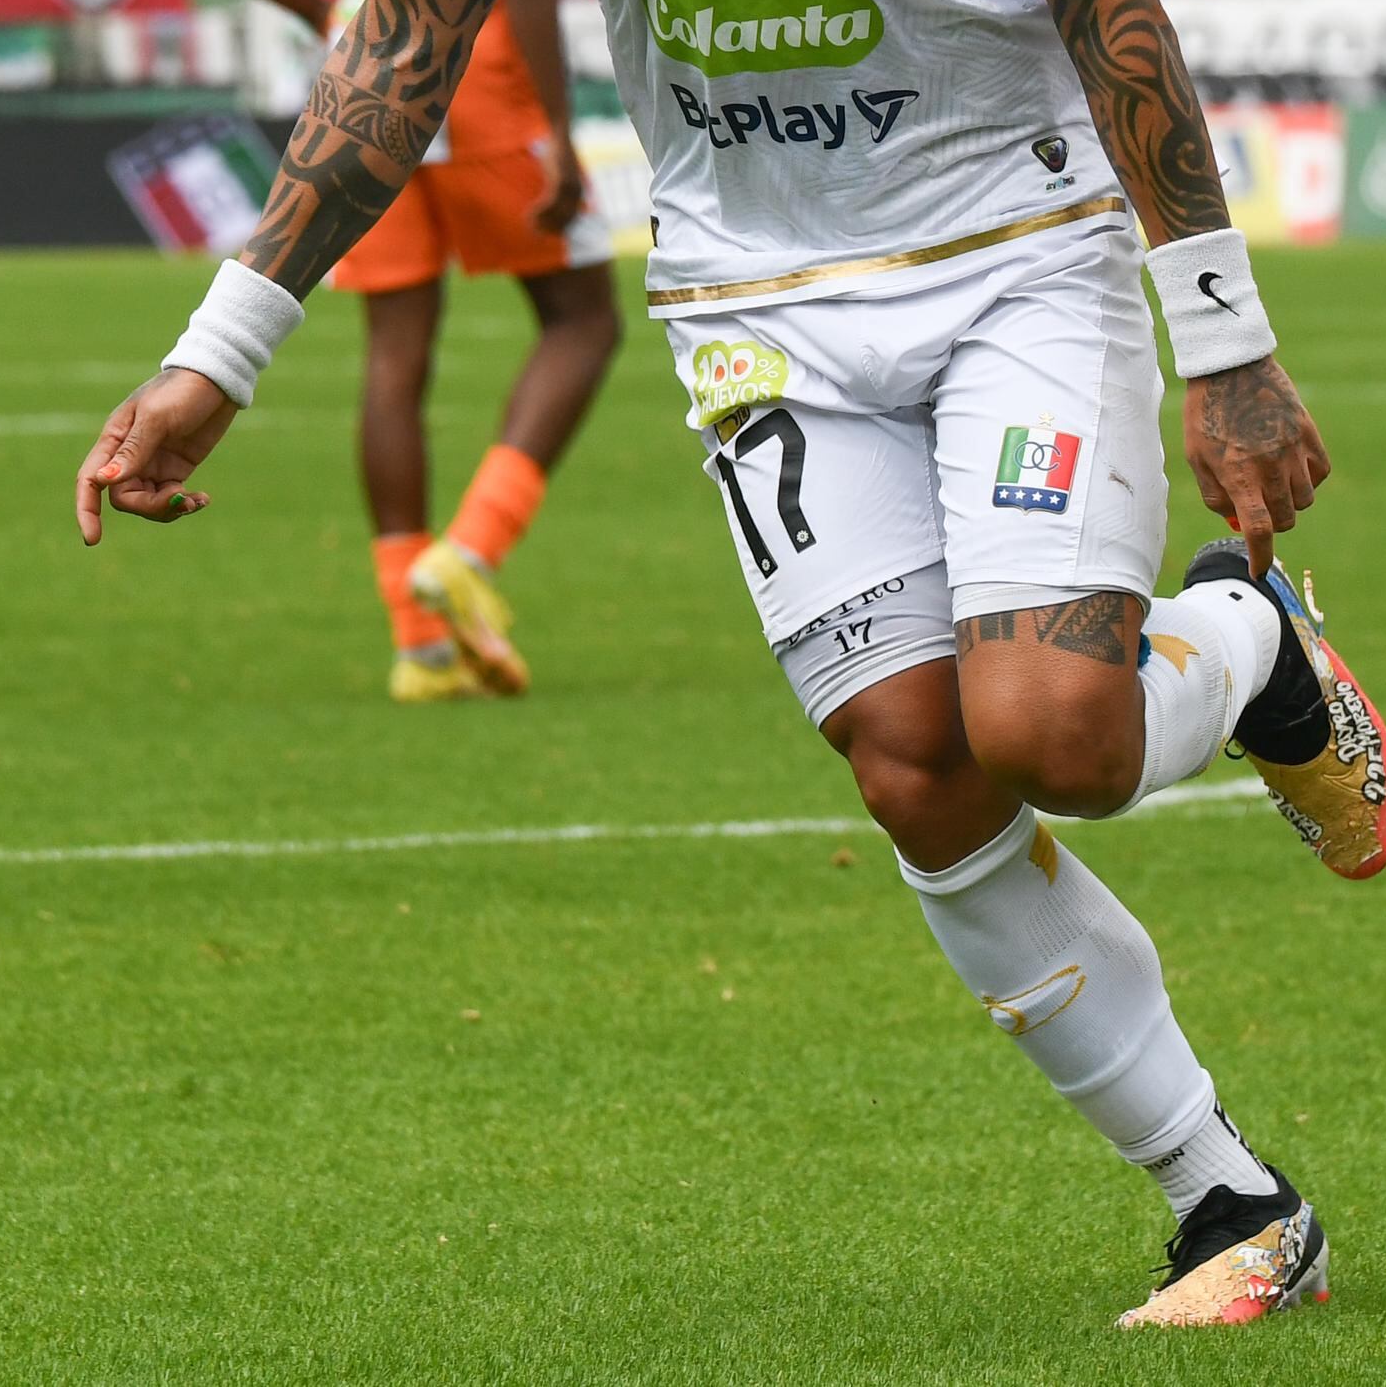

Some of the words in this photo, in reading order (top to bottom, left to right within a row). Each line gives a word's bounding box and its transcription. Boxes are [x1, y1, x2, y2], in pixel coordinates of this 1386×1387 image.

[670, 83, 846, 150] BtPlay
[698, 347, 780, 393] 100%
[715, 408, 817, 580] 17
[833, 616, 873, 656] 17
